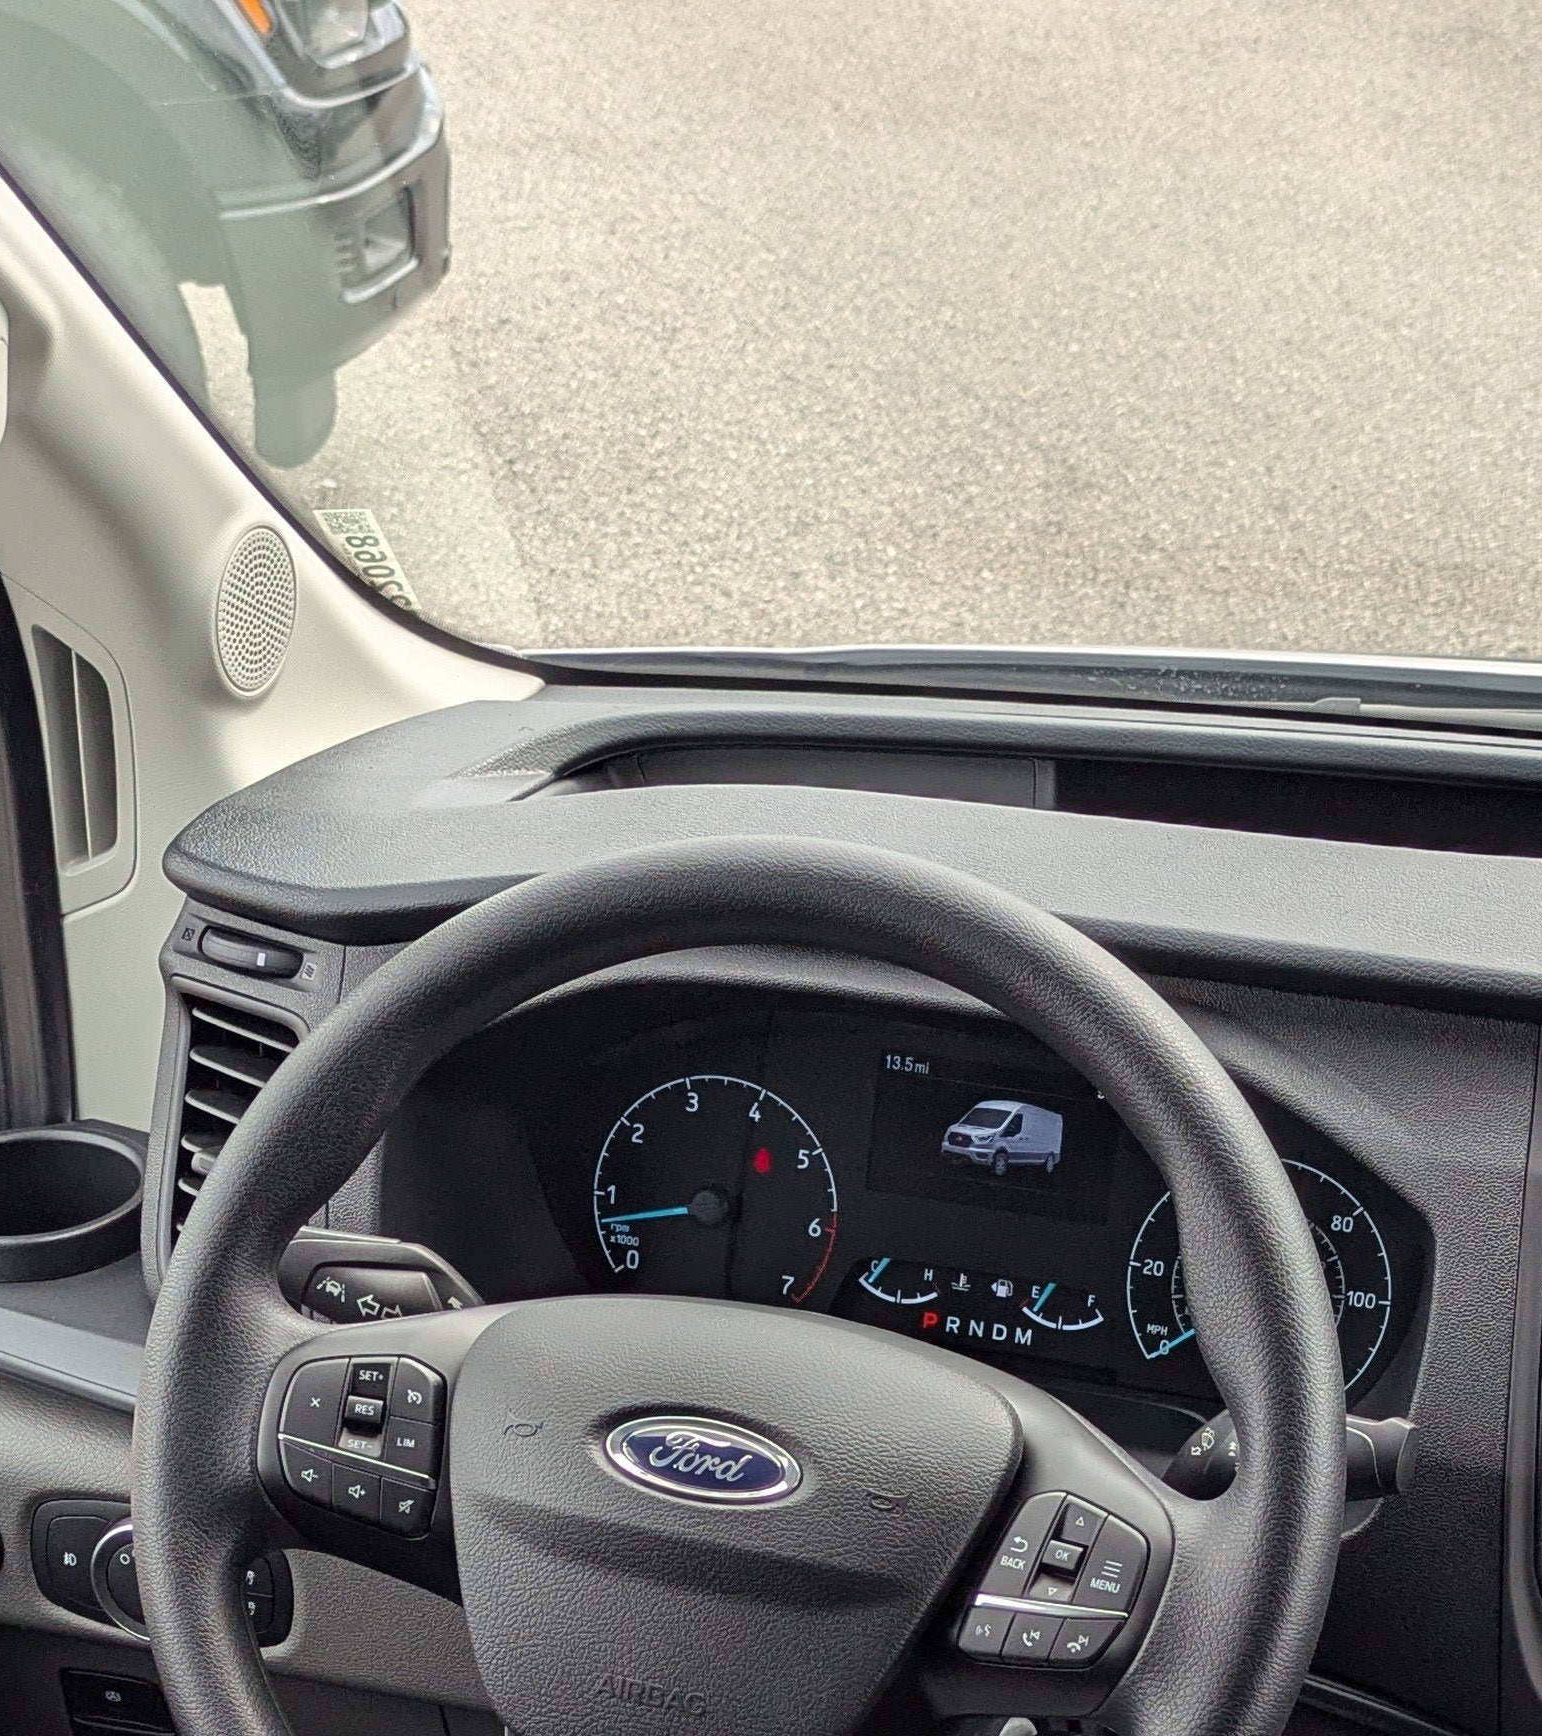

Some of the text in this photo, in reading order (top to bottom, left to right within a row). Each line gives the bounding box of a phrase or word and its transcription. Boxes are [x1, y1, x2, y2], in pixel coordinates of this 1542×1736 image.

[686, 1092, 699, 1113] 3
[748, 1103, 761, 1123] 4
[631, 1122, 645, 1143] 2
[797, 1149, 810, 1169] 5
[607, 1184, 616, 1203] 1
[808, 1218, 821, 1238] 6
[1330, 1214, 1354, 1233] 80
[626, 1250, 639, 1270] 0
[1142, 1258, 1164, 1277] 20
[924, 1268, 933, 1280] H
[781, 1276, 794, 1295] 7
[1032, 1285, 1041, 1299] E
[1087, 1294, 1096, 1307] F
[1347, 1291, 1376, 1310] 100
[923, 1312, 1033, 1346] P R N D M
[1147, 1325, 1168, 1336] MPH
[354, 1404, 375, 1416] RES
[396, 1437, 415, 1448] LIM
[649, 1431, 753, 1483] Ford
[1000, 1555, 1026, 1571] BACK
[1055, 1549, 1070, 1561] OK
[1090, 1576, 1121, 1594] MENU
[596, 1675, 707, 1717] AIRBAG
